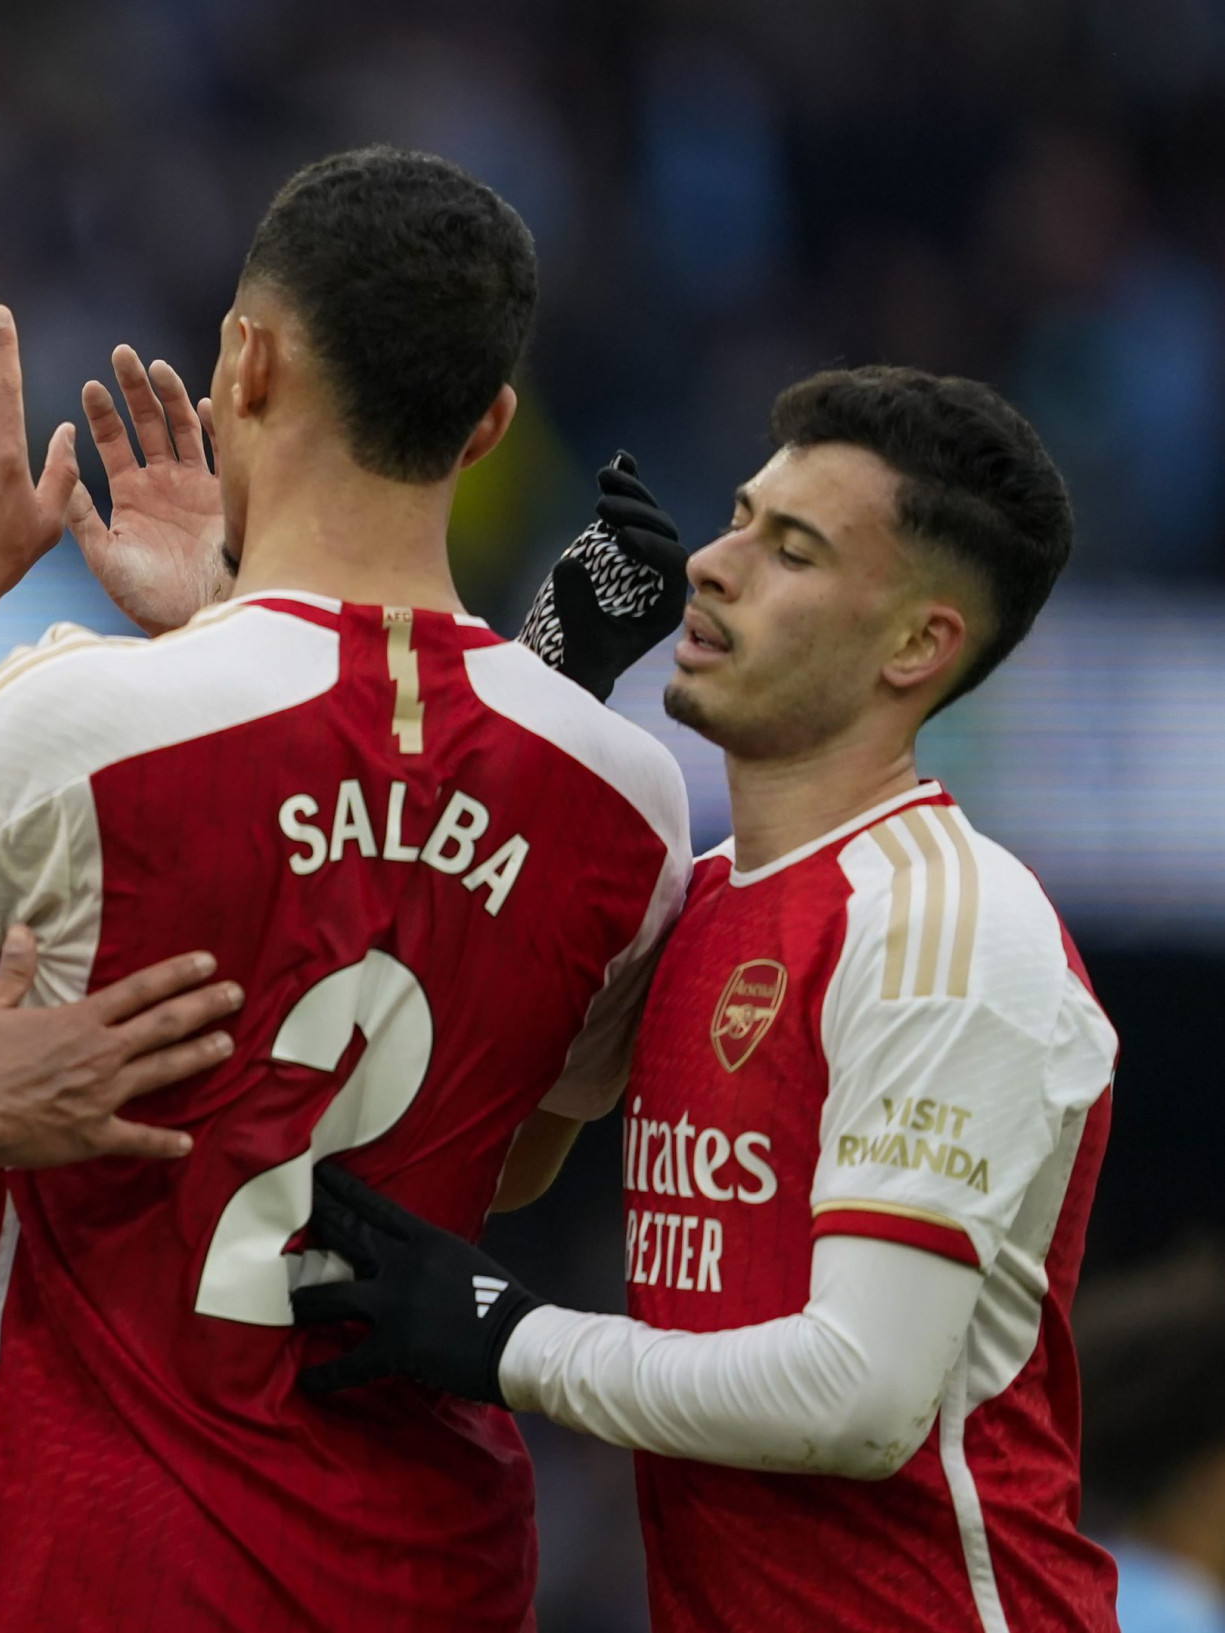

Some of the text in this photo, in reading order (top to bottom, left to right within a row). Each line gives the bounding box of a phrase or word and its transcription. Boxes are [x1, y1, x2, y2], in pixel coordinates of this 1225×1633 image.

[386, 612, 412, 622] AFC
[278, 778, 530, 917] SALBA
[194, 948, 433, 1326] 2
[623, 1095, 778, 1204] irates
[882, 1096, 972, 1140] VISIT
[836, 1132, 989, 1195] RWANDA
[625, 1208, 723, 1292] BETTER
